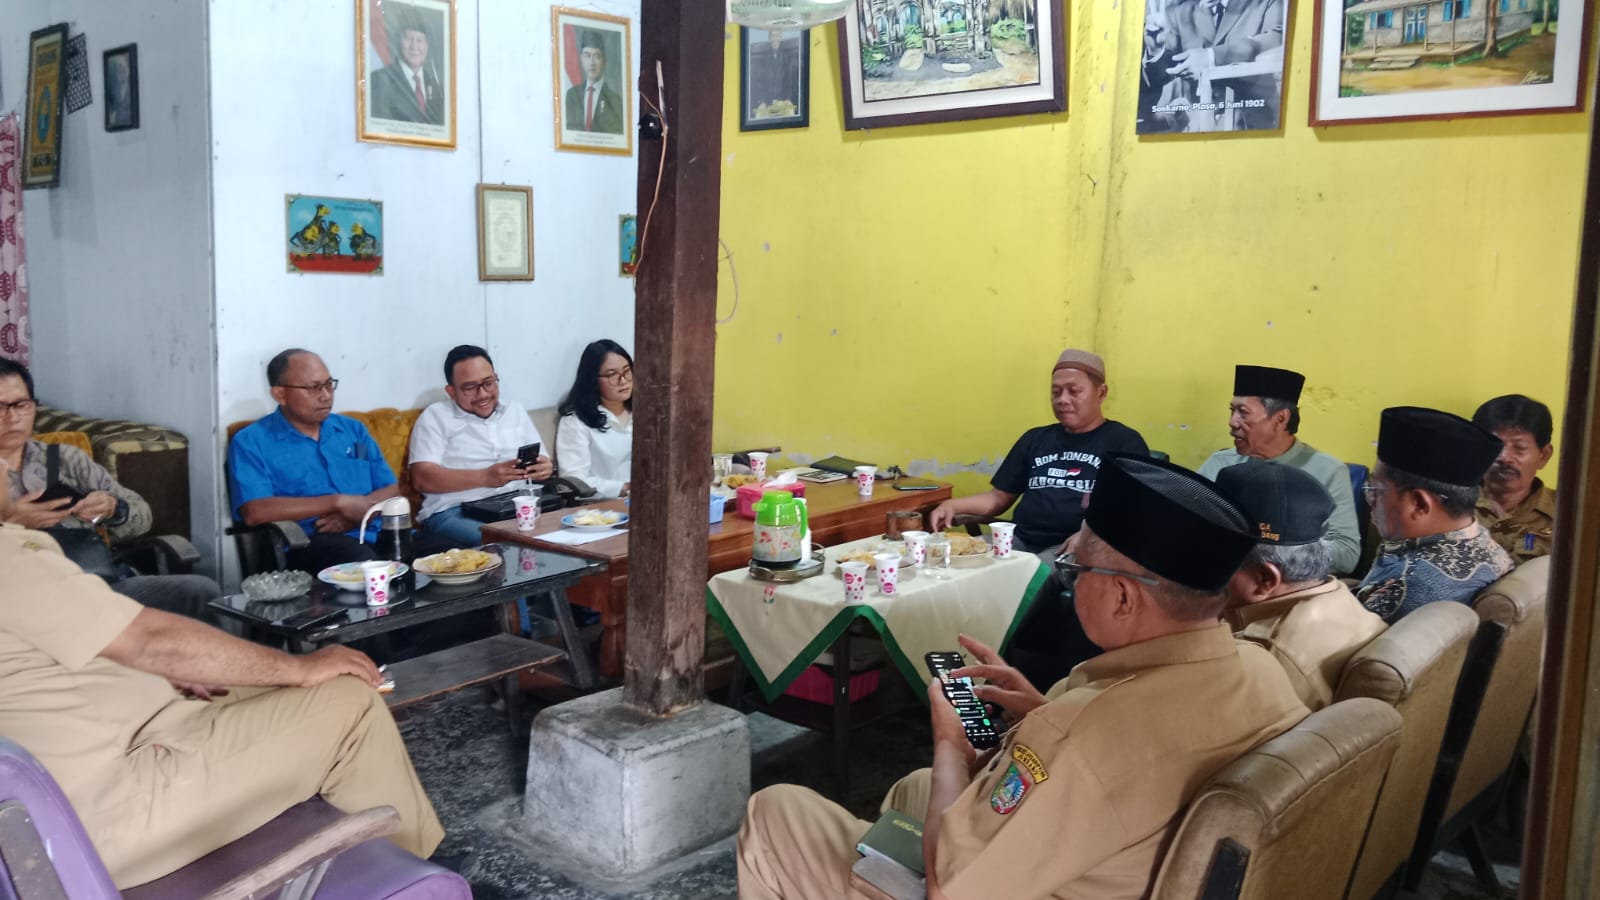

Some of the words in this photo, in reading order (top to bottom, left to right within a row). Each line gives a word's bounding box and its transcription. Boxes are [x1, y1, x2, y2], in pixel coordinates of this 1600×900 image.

[1192, 102, 1217, 112] Ploso,
[1218, 101, 1224, 109] 6
[1225, 100, 1244, 110] Juni
[1245, 99, 1265, 108] 1902
[1031, 453, 1058, 469] ROM
[1060, 451, 1101, 469] JOMBAN
